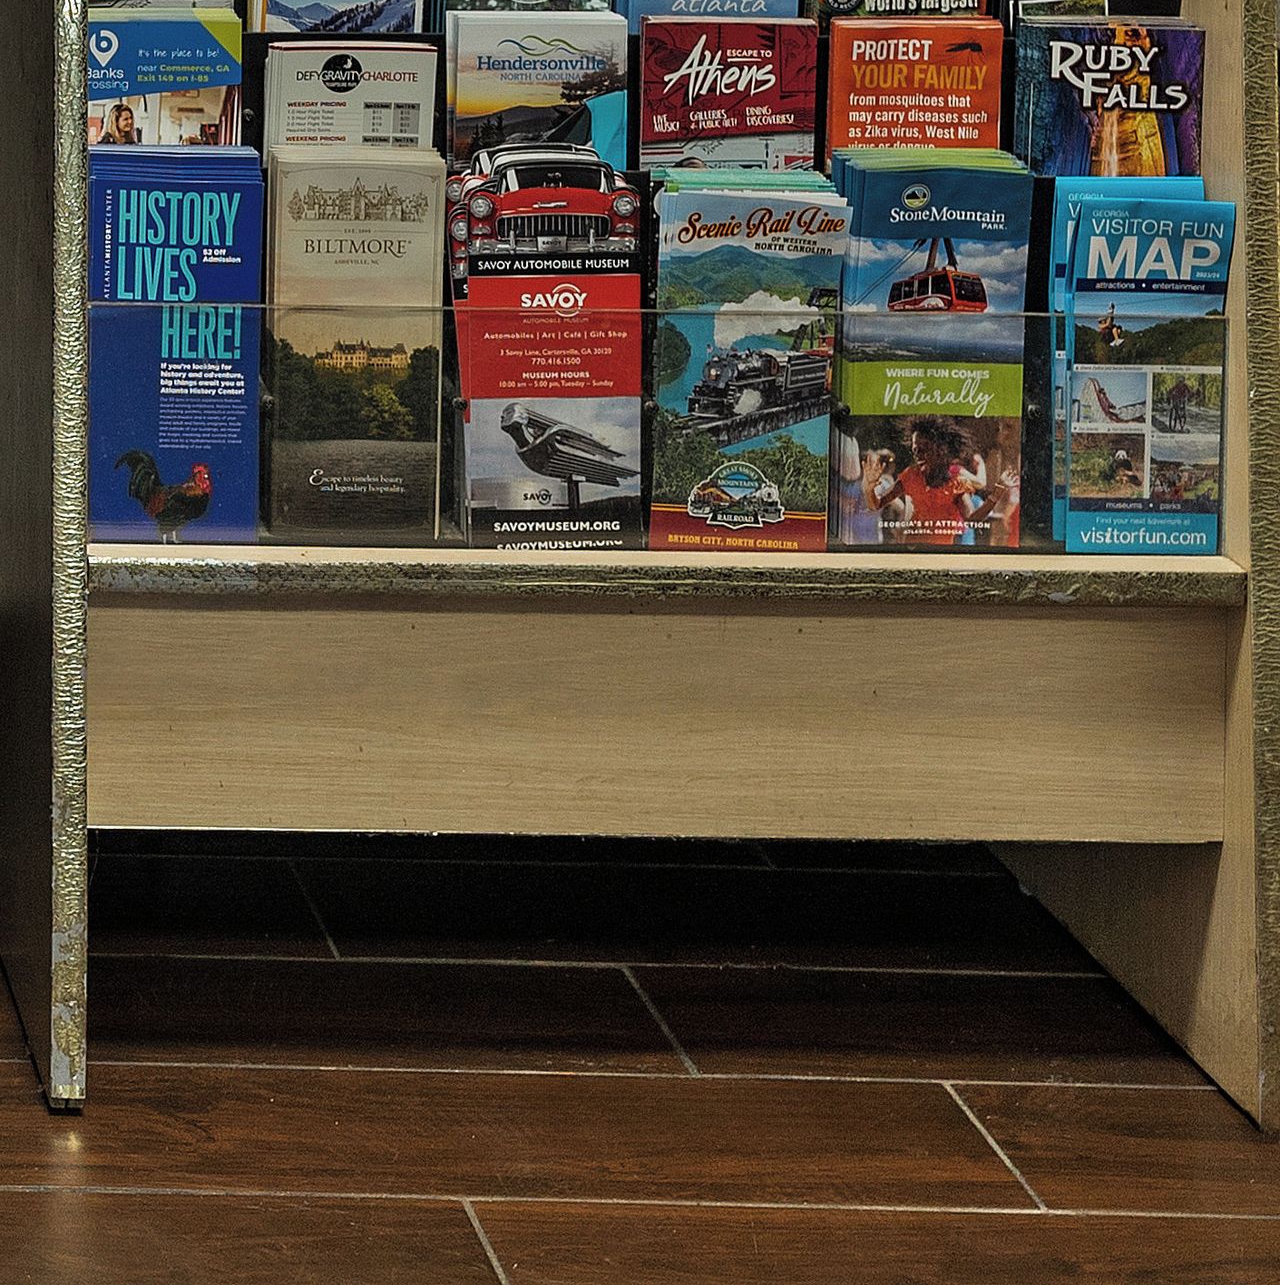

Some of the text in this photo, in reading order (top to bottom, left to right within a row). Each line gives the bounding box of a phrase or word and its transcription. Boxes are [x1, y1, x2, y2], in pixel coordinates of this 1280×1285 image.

[852, 39, 932, 62] PROTECT
[1050, 41, 1159, 81] RUBY
[663, 34, 776, 107] Athens
[852, 64, 988, 90] YOUR FAMILY
[849, 94, 970, 108] from mosquitoes that
[1081, 72, 1189, 110] FALLS
[848, 109, 988, 125] may carry diseases such
[848, 126, 979, 140] as Zika virus, West Nile
[118, 189, 241, 246] HISTORY
[478, 259, 629, 270] SAVOY AUTOMOBILE MUSEUM
[1087, 236, 1222, 279] MAP
[118, 246, 197, 301] LIVES
[521, 292, 587, 308] SAVOY
[161, 306, 241, 359] HERE!
[886, 369, 989, 379] WHERE FUN COMES
[883, 375, 995, 419] Naturally
[493, 521, 620, 533] SAVOYMUSEUM.ORG
[1080, 528, 1206, 545] visitorfun.com
